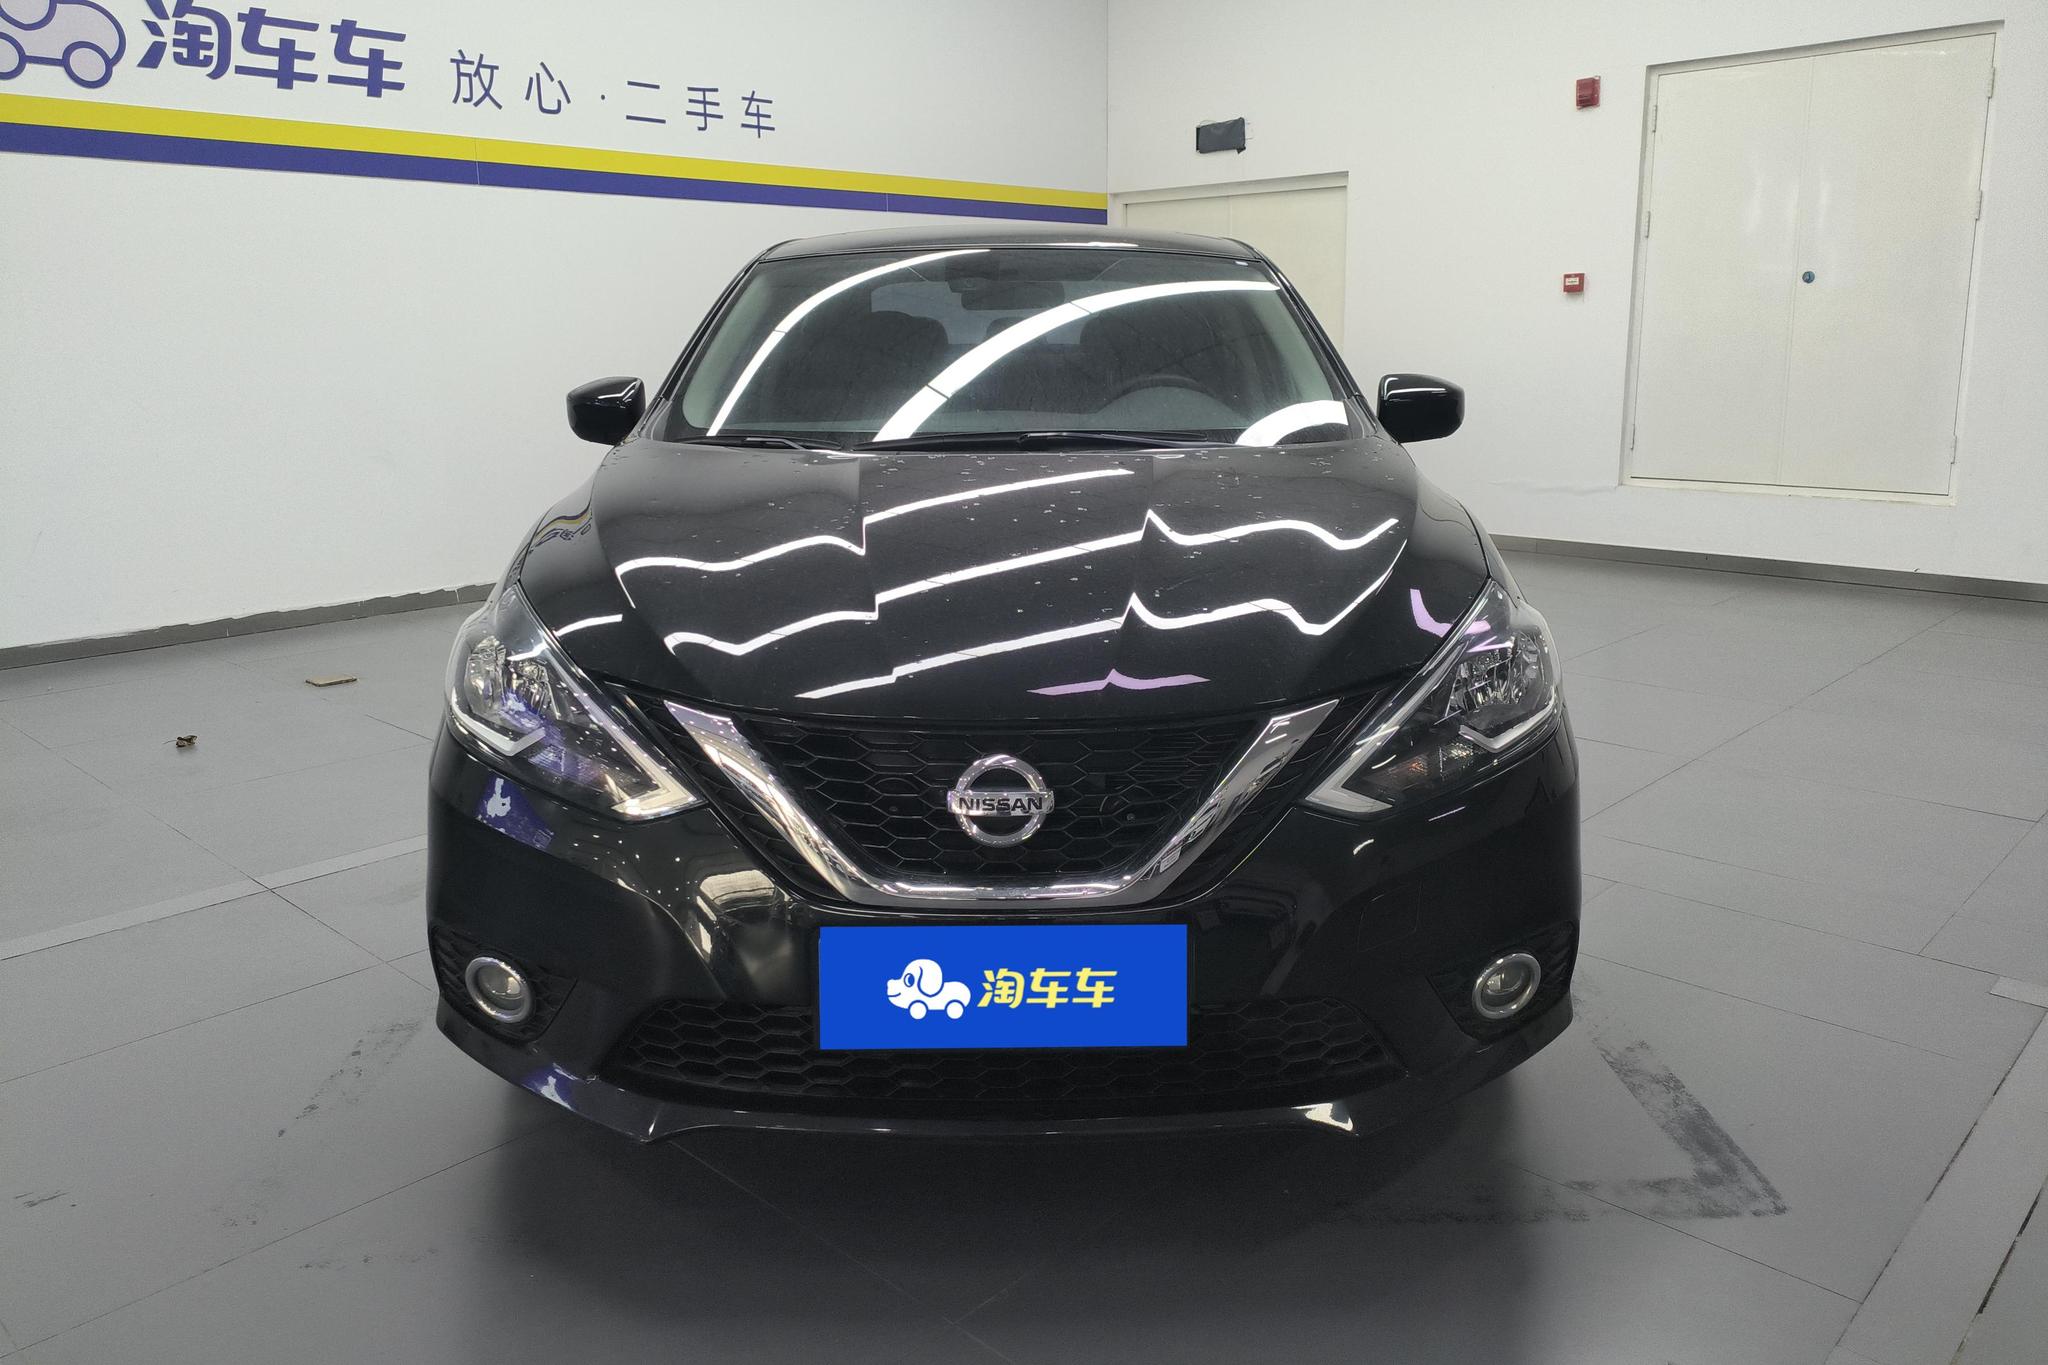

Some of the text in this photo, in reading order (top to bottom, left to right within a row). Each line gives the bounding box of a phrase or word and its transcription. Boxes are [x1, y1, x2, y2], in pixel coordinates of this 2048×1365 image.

[137, 0, 407, 98] 淘车车
[959, 797, 1043, 813] NISSAN
